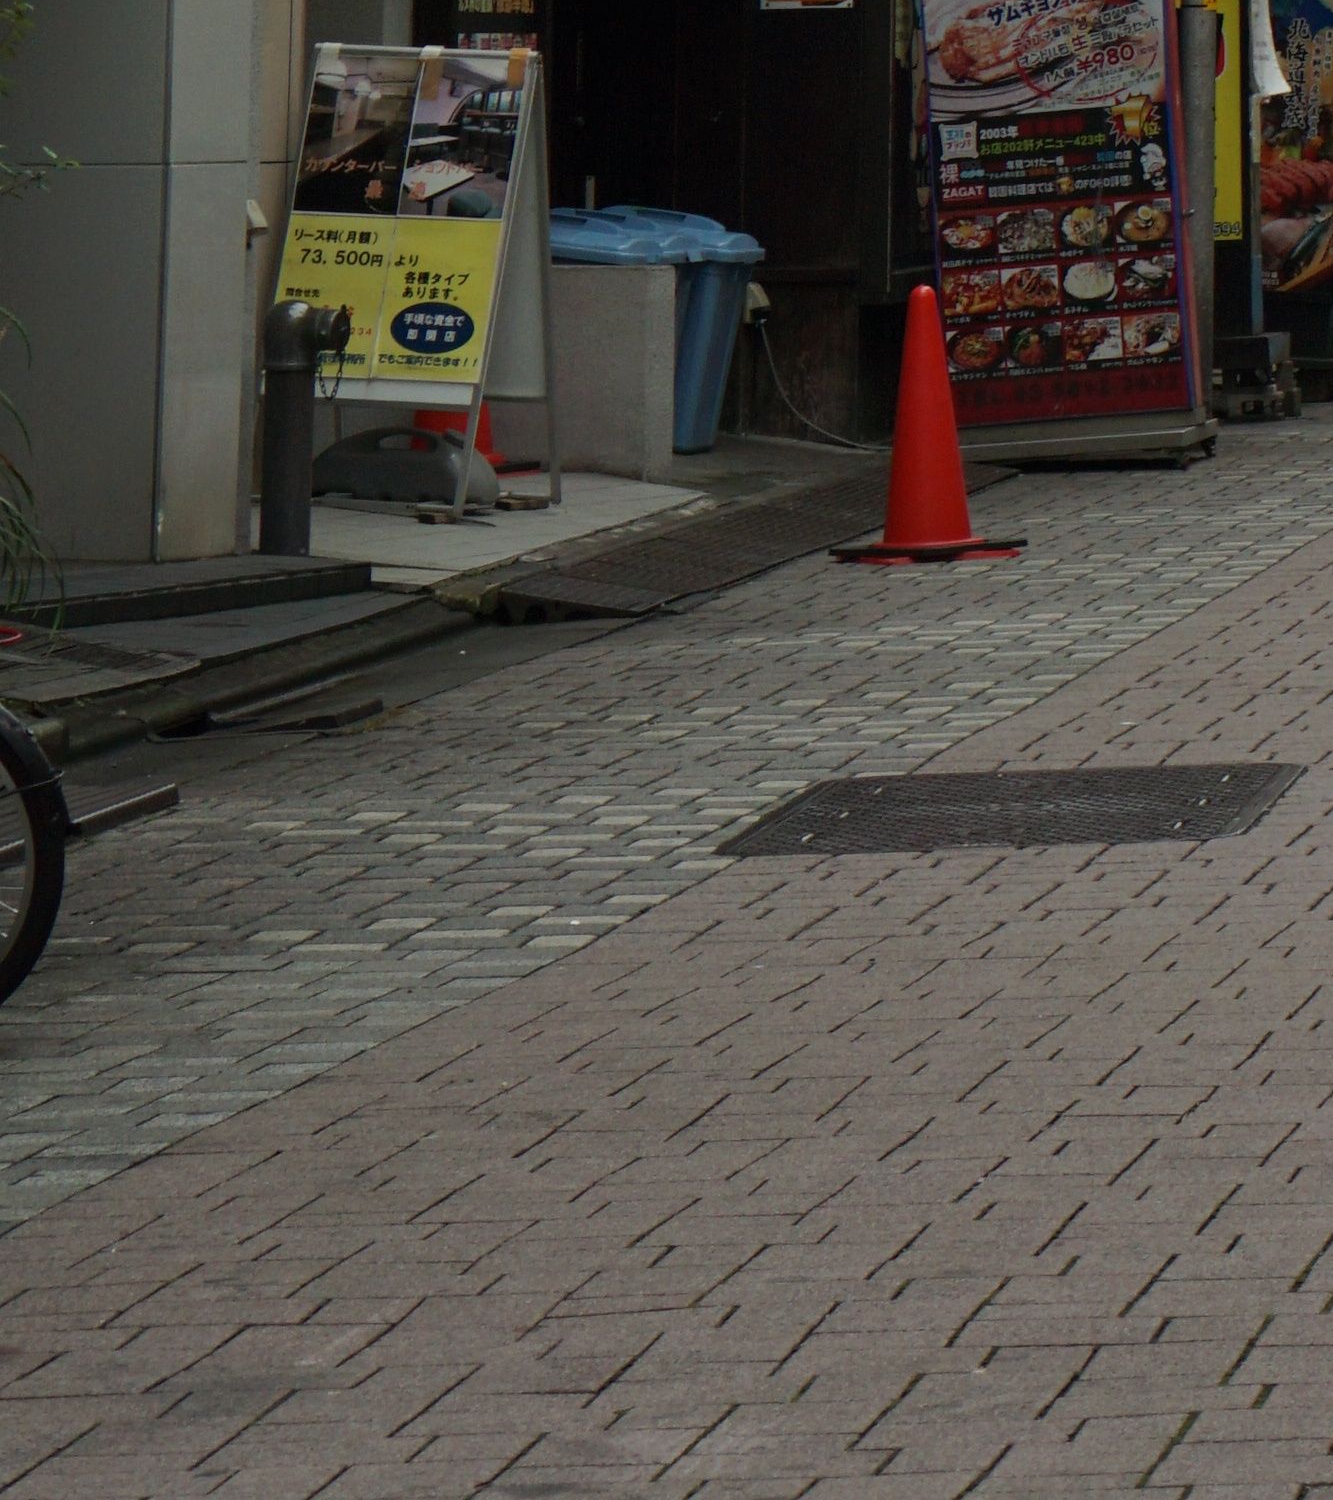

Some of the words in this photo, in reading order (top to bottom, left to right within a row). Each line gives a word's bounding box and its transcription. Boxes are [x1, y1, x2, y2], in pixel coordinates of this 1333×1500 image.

[1075, 42, 1135, 75] ¥980
[941, 184, 985, 199] ZAGAT
[393, 254, 421, 268] より
[403, 269, 470, 286] 各種タイプ
[285, 286, 321, 299] 問合せ先
[401, 285, 460, 302] あります。
